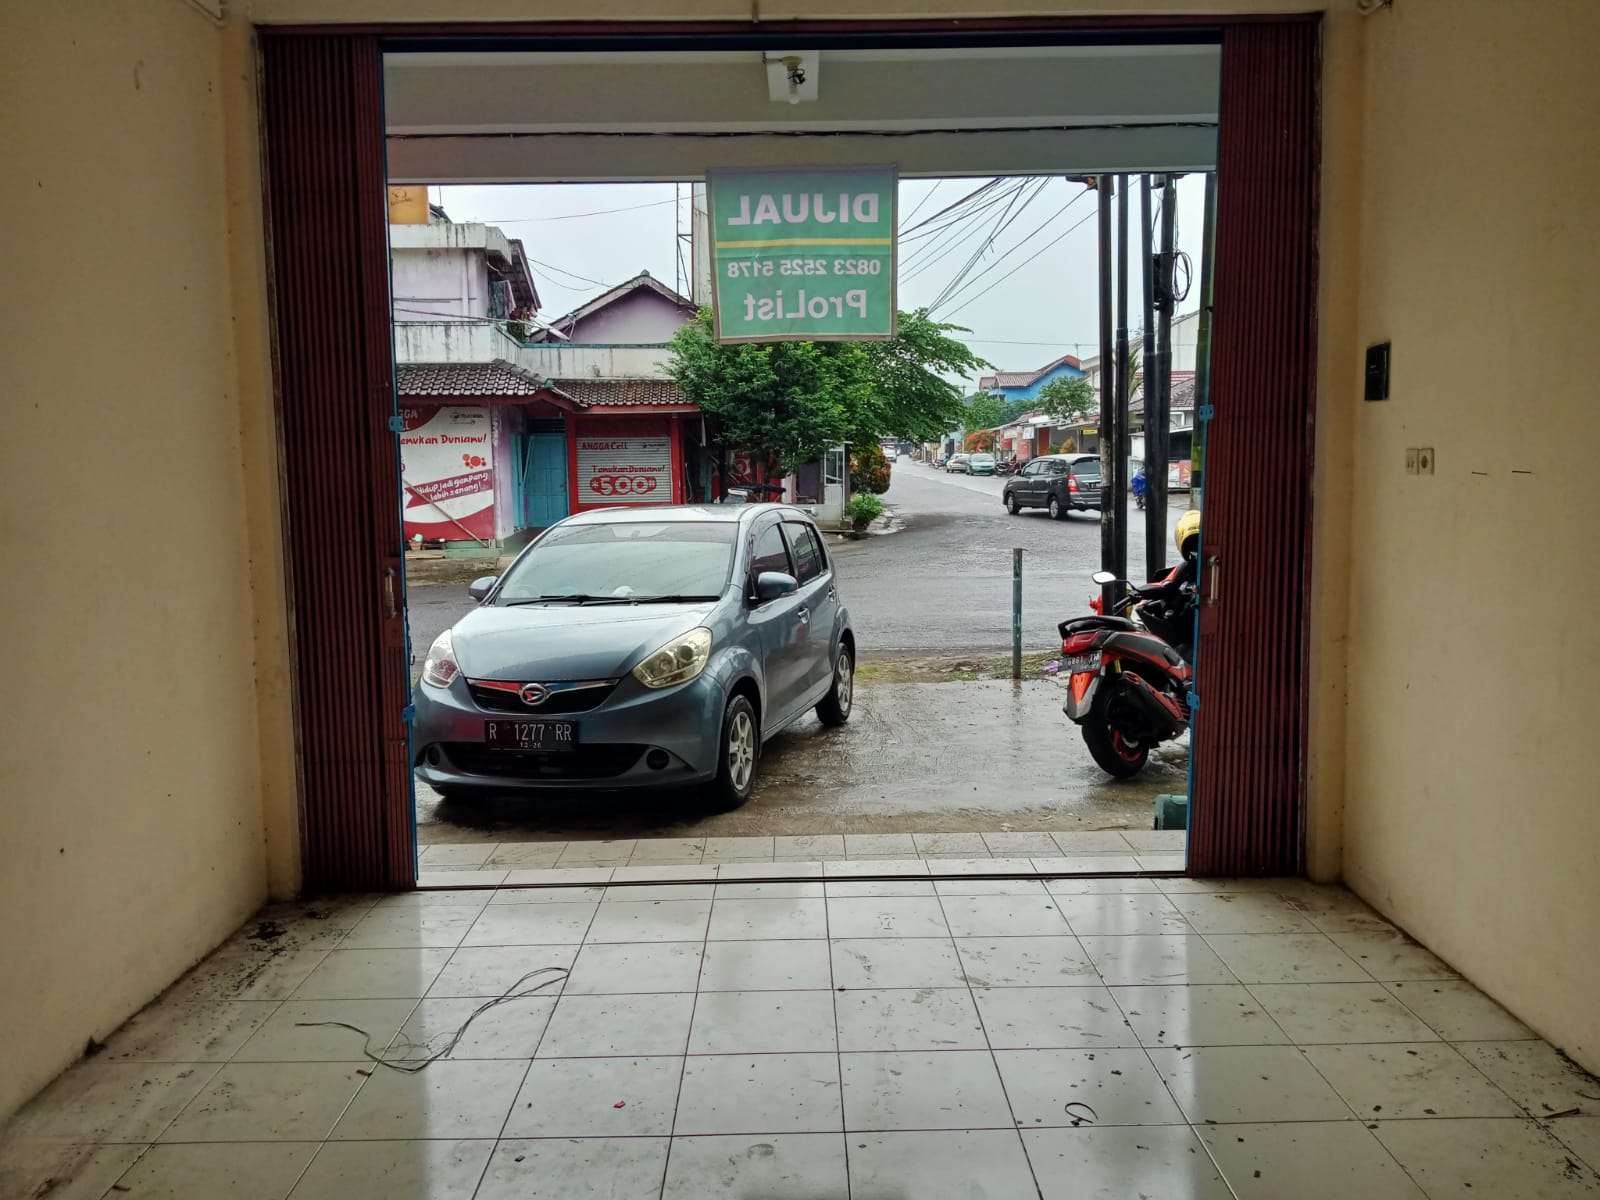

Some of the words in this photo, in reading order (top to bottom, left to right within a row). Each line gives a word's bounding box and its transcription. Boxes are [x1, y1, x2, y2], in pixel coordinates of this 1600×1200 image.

[401, 435, 437, 445] emukan
[489, 723, 497, 740] R
[514, 723, 545, 740] 1277
[555, 724, 572, 741] RR
